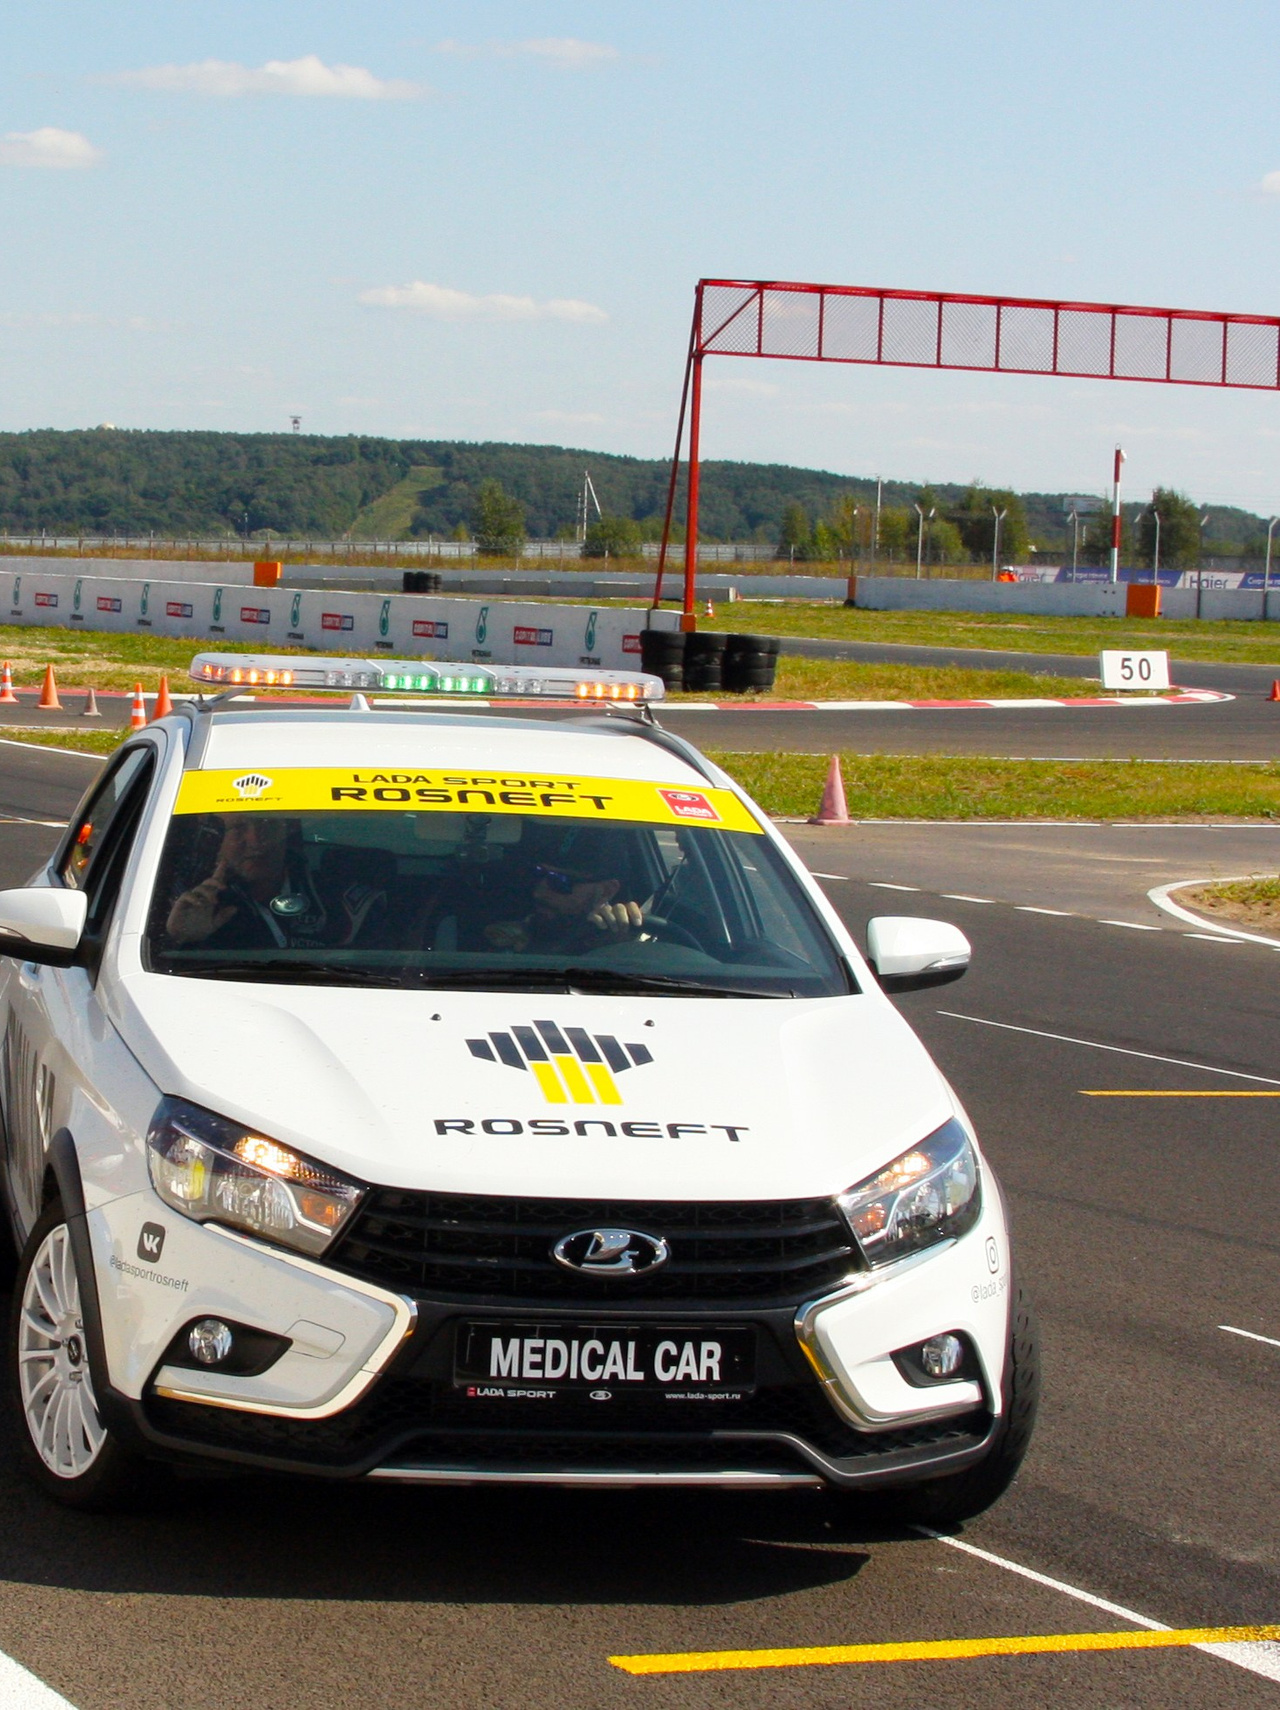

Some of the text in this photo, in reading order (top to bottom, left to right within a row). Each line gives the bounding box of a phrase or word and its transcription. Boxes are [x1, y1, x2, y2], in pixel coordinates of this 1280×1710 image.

[1121, 658, 1151, 681] 50
[353, 774, 581, 790] LADA SPORT
[331, 787, 613, 810] ROSNEFT
[433, 1118, 750, 1142] ROSNEFT
[490, 1337, 722, 1382] MEDICAL CAR
[476, 1387, 557, 1399] LADA SPORT
[665, 1391, 742, 1401] www.lada-sport.ru
